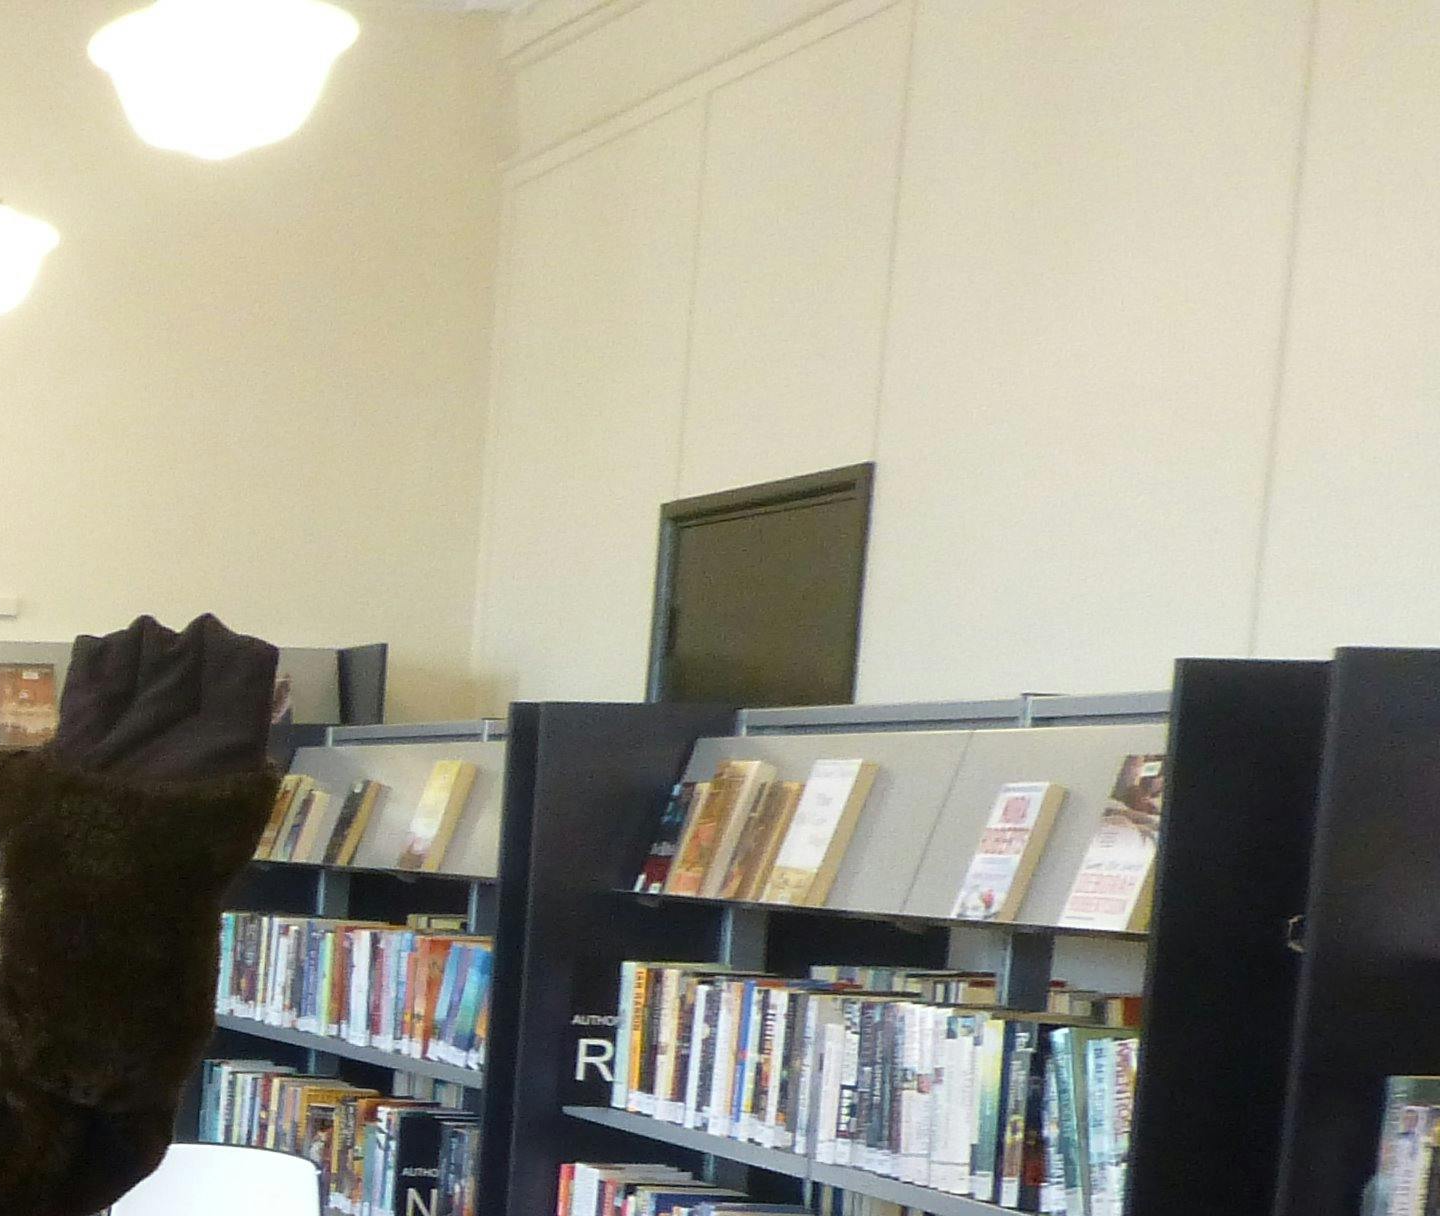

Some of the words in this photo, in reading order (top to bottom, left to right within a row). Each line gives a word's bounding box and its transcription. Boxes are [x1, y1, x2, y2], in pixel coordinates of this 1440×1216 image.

[570, 1014, 616, 1028] AUTHO
[575, 1038, 615, 1082] R
[402, 1167, 440, 1178] AUTHO
